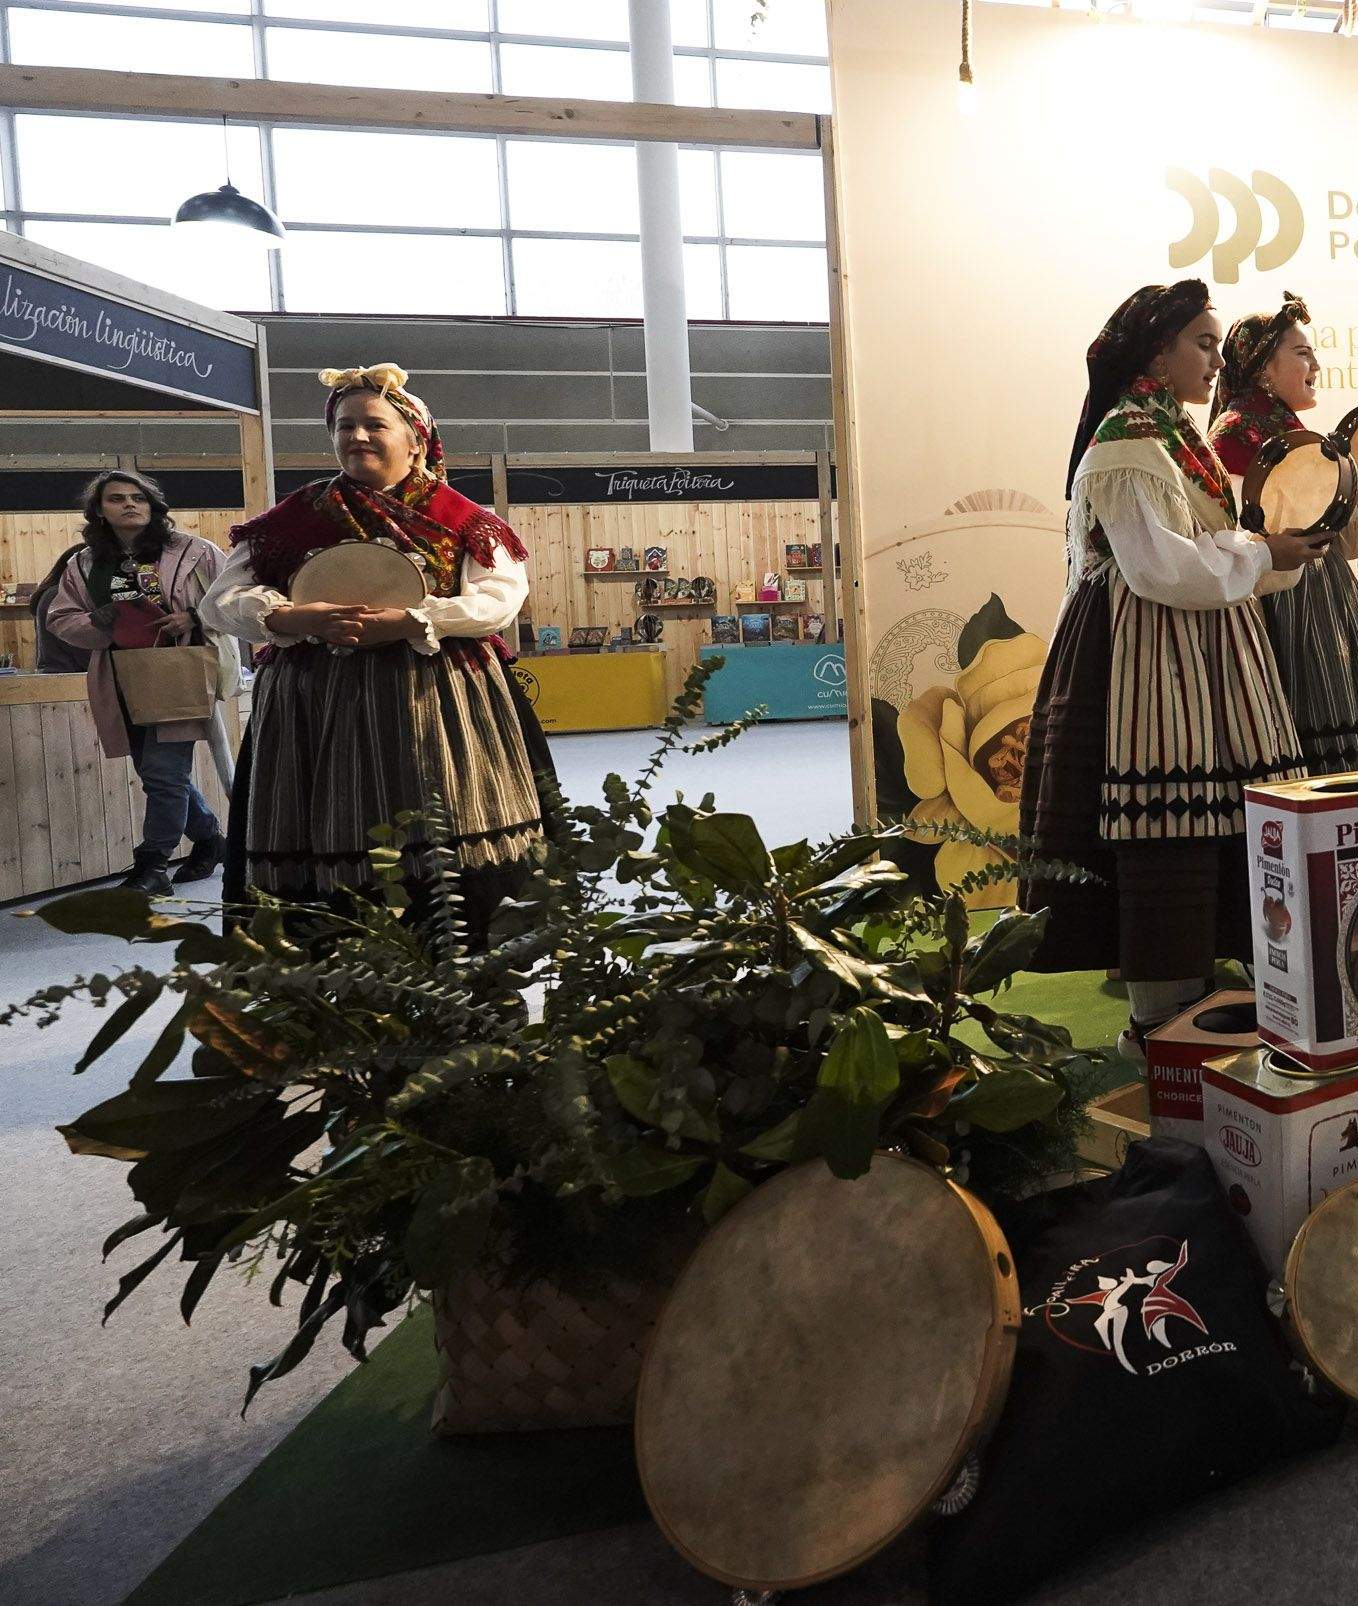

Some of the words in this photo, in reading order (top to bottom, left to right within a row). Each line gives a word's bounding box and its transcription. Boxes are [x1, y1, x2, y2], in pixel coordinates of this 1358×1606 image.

[0, 274, 93, 341] lización
[594, 470, 668, 500] Triqueta
[1153, 1065, 1203, 1083] PIMENT
[1157, 1090, 1203, 1103] CHORICE
[1217, 1103, 1262, 1134] PIMENTON
[1222, 1127, 1256, 1164] JAUJA
